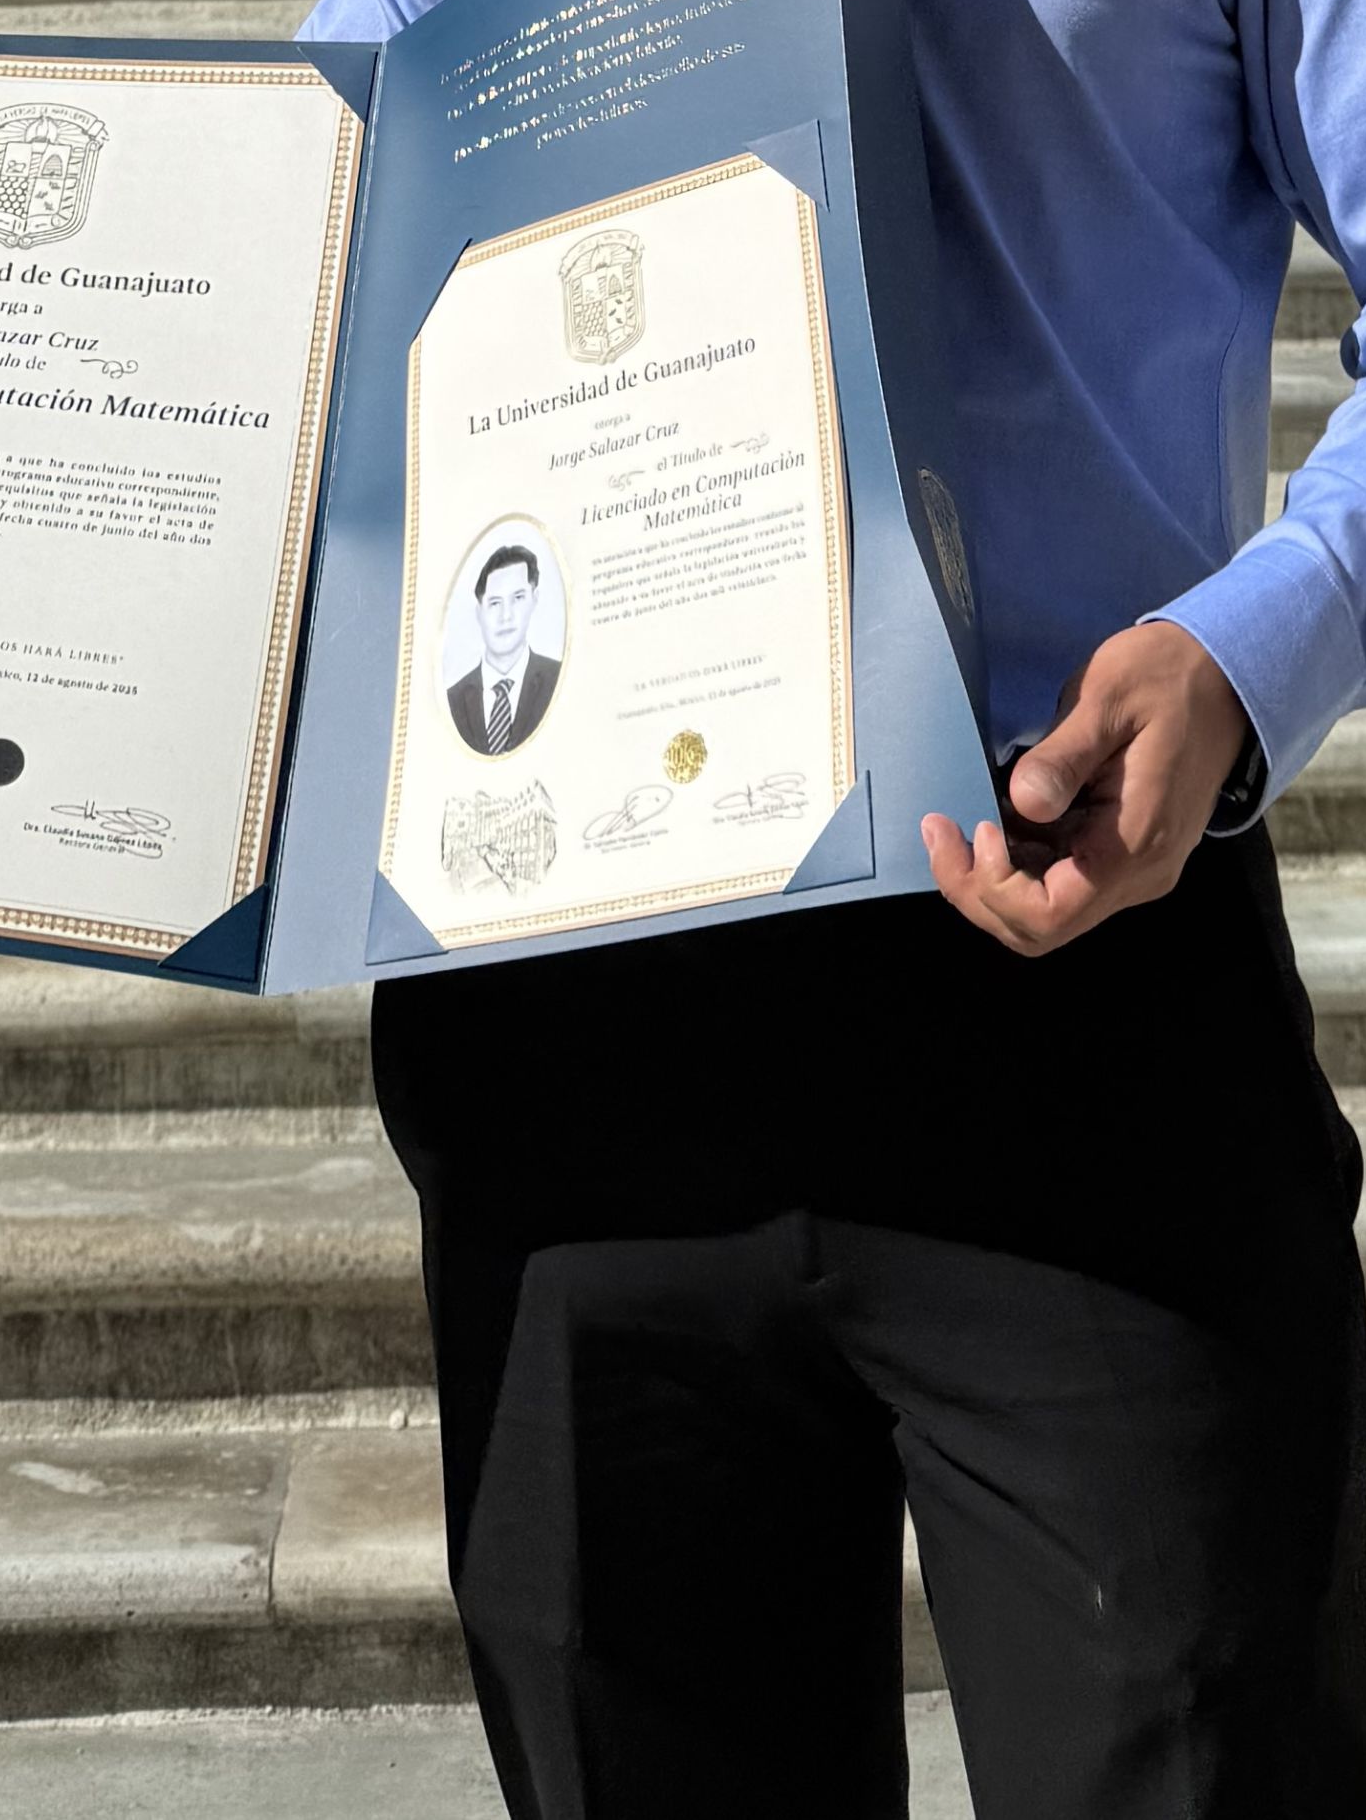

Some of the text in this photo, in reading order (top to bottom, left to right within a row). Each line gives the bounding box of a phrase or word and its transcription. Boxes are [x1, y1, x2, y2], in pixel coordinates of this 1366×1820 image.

[21, 264, 51, 284] de
[61, 268, 210, 297] Guanajuato
[34, 305, 42, 314] a
[49, 332, 98, 350] Cruz
[26, 356, 46, 370] de
[470, 339, 755, 435] La Universidad de Guanajuato
[101, 395, 269, 428] Matemática
[549, 423, 678, 470] Jorge Salazar Cruz
[582, 451, 804, 525] Licenciado en Computación
[644, 488, 741, 531] Matemática
